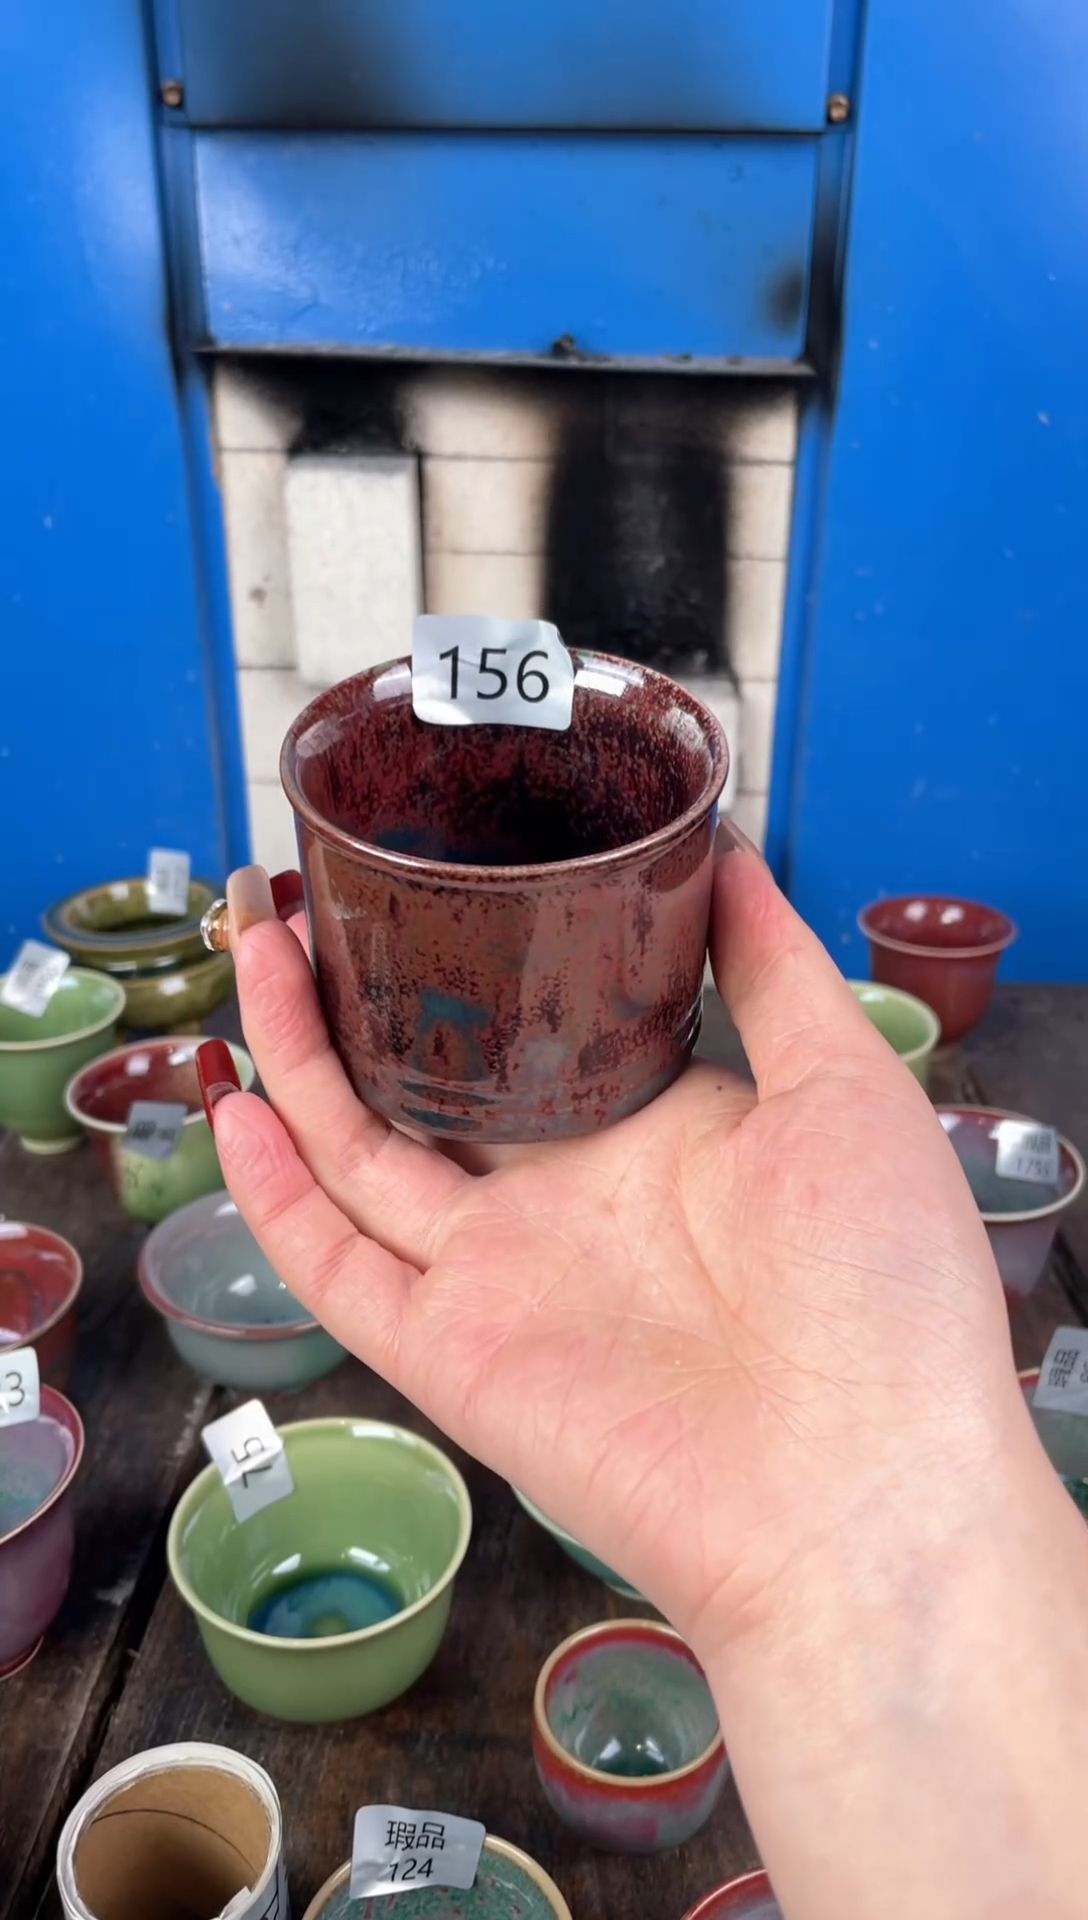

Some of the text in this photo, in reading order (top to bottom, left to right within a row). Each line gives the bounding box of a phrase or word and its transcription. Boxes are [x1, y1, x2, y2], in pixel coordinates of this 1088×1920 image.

[440, 645, 550, 704] 156
[0, 1371, 25, 1408] 3
[231, 1437, 273, 1489] 75
[385, 1820, 446, 1852] 瑕品
[389, 1857, 434, 1882] 124
